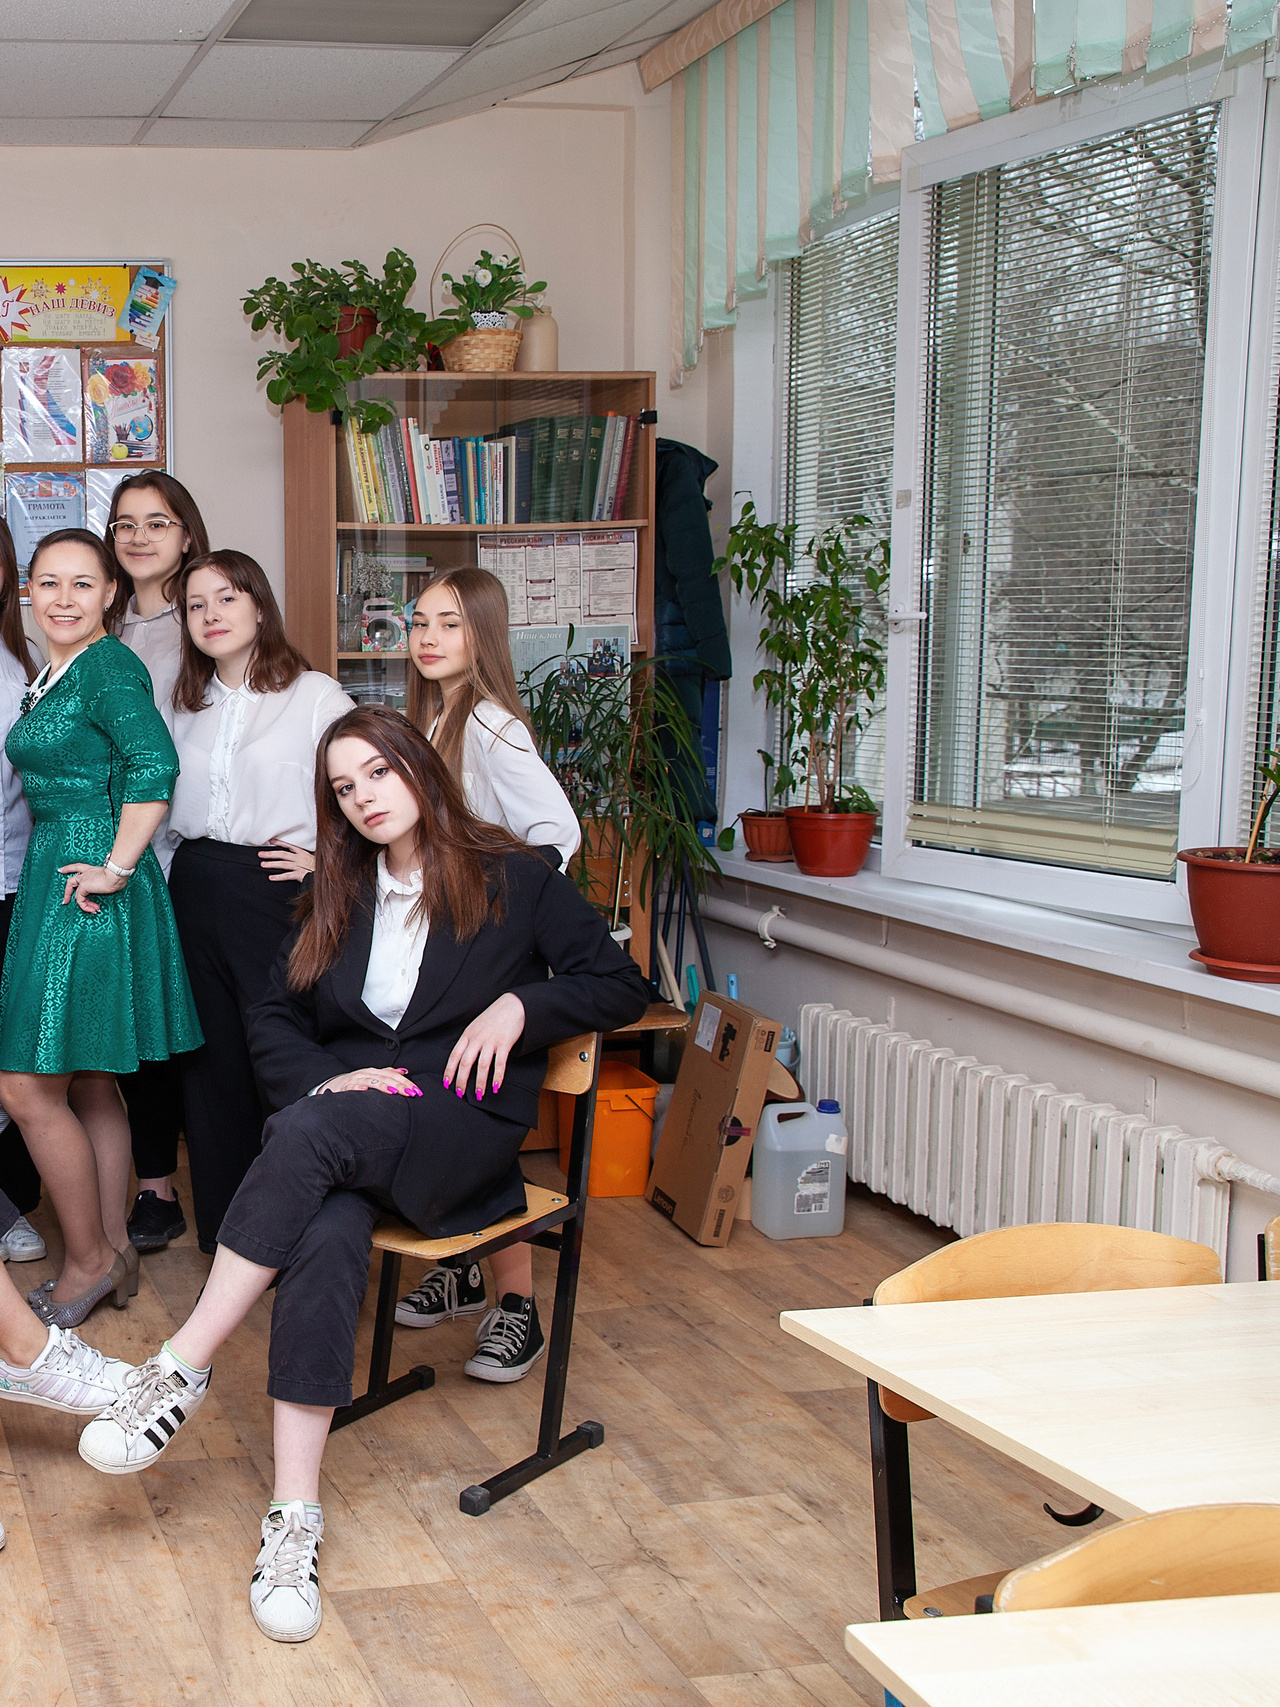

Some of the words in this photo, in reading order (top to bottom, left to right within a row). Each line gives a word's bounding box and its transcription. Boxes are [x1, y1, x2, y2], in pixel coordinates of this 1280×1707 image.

[29, 298, 66, 316] НАШ
[69, 298, 116, 318] ДЕВИЗ
[609, 474, 617, 488] Что
[613, 440, 622, 454] Кто
[28, 503, 66, 511] ГРАМОТА
[526, 536, 544, 544] ЯЗЫК
[516, 631, 538, 640] Наш
[539, 632, 563, 640] класс
[652, 1190, 672, 1214] Lenovo
